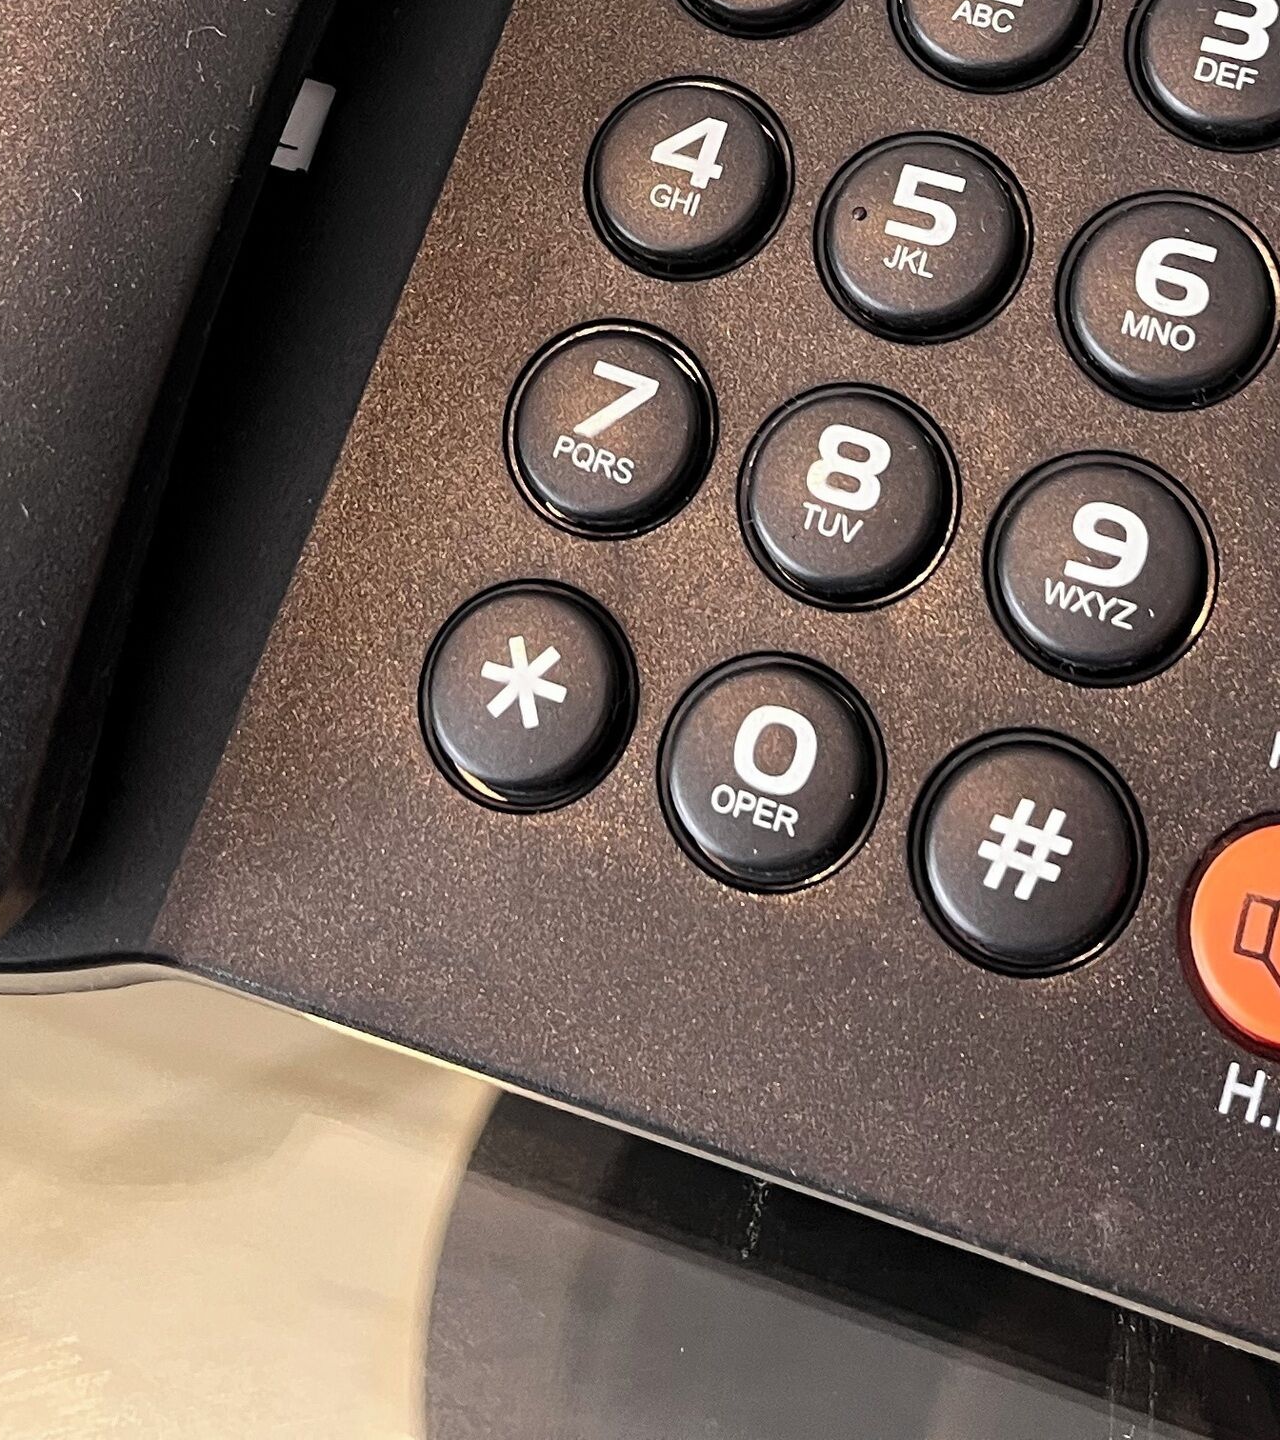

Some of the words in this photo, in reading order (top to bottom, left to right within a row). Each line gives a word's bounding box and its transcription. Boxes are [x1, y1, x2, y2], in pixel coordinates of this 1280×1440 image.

[951, 0, 1013, 34] ABC
[1193, 55, 1259, 92] DEF
[651, 116, 728, 190] 4
[649, 182, 701, 217] GHI
[884, 164, 968, 247] 5
[883, 243, 934, 279] JKL
[1133, 237, 1219, 317] 6
[1120, 310, 1196, 353] MNO
[573, 361, 660, 438] 7
[552, 435, 636, 485] PQRS
[805, 423, 892, 512] 8
[801, 501, 864, 544] TUV
[1063, 501, 1149, 588] 9
[1044, 577, 1138, 631] WXYZ
[710, 783, 800, 838] OPER
